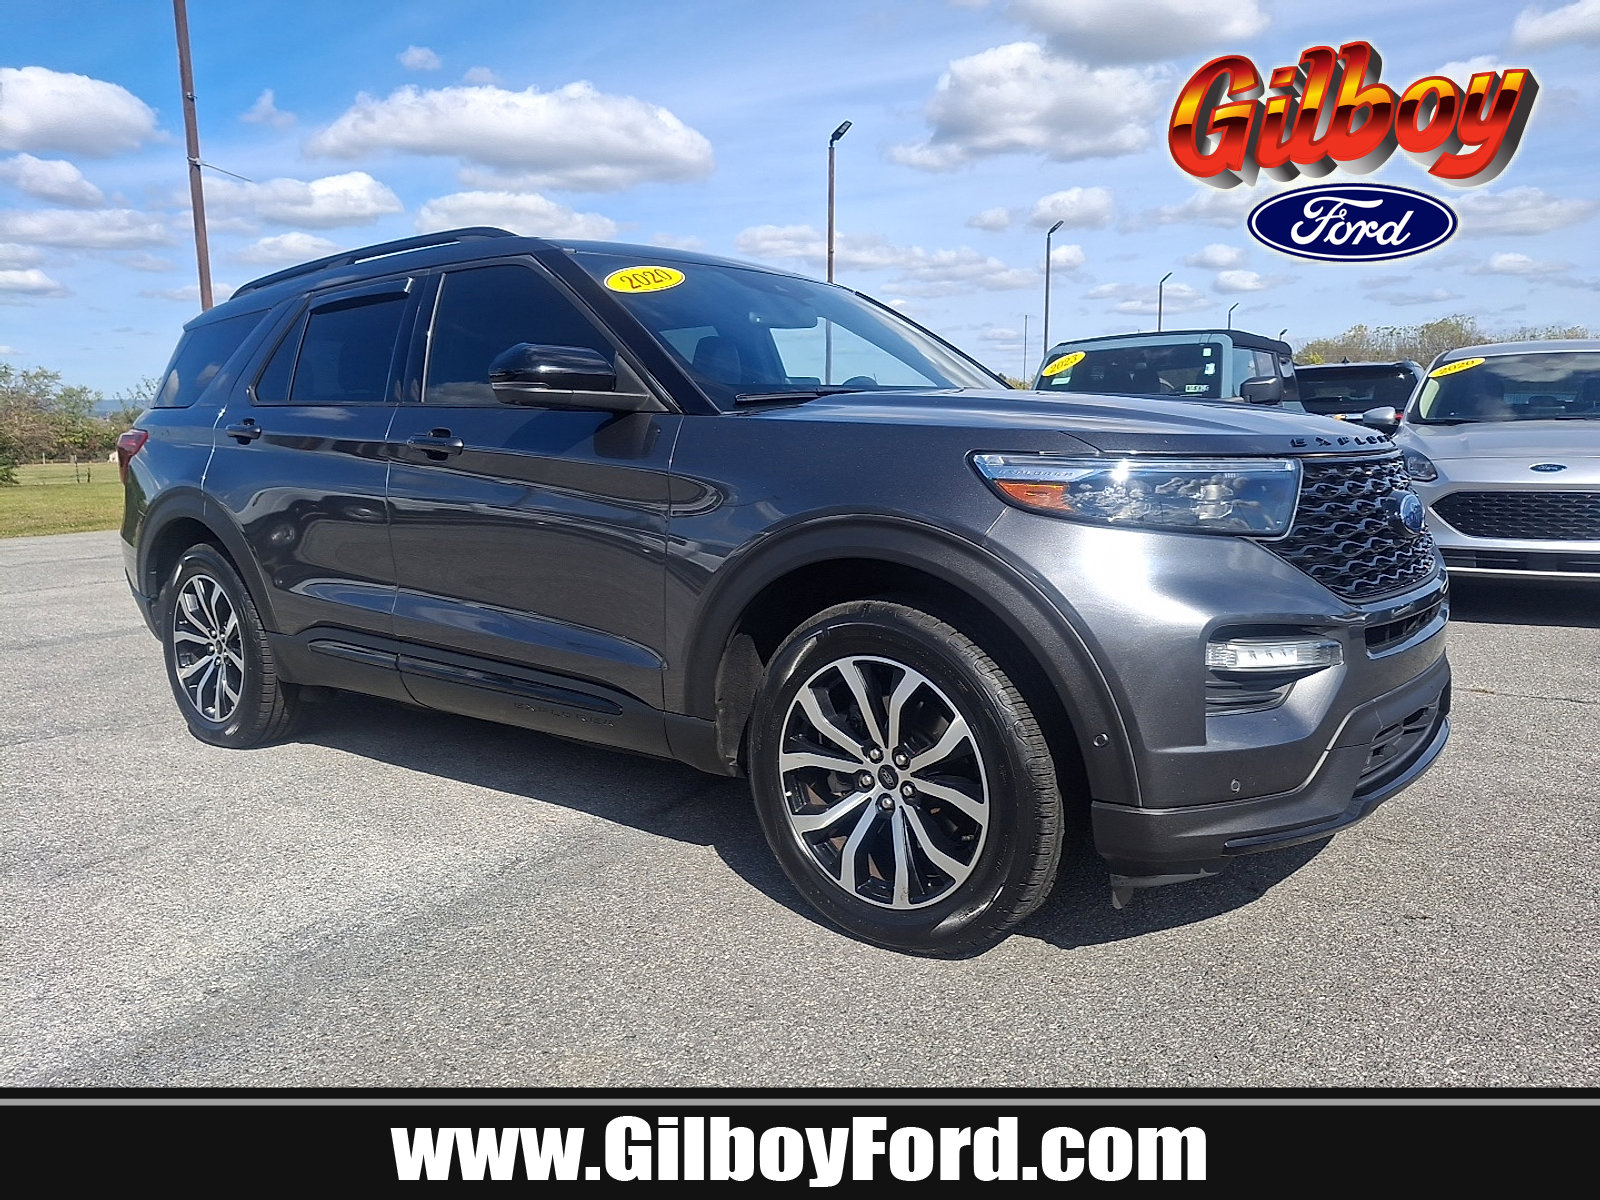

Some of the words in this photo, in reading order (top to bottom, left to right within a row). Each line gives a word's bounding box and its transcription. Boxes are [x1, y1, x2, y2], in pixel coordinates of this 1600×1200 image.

[619, 268, 673, 289] 2020
[1050, 354, 1079, 374] 2023
[1438, 360, 1475, 374] 2020
